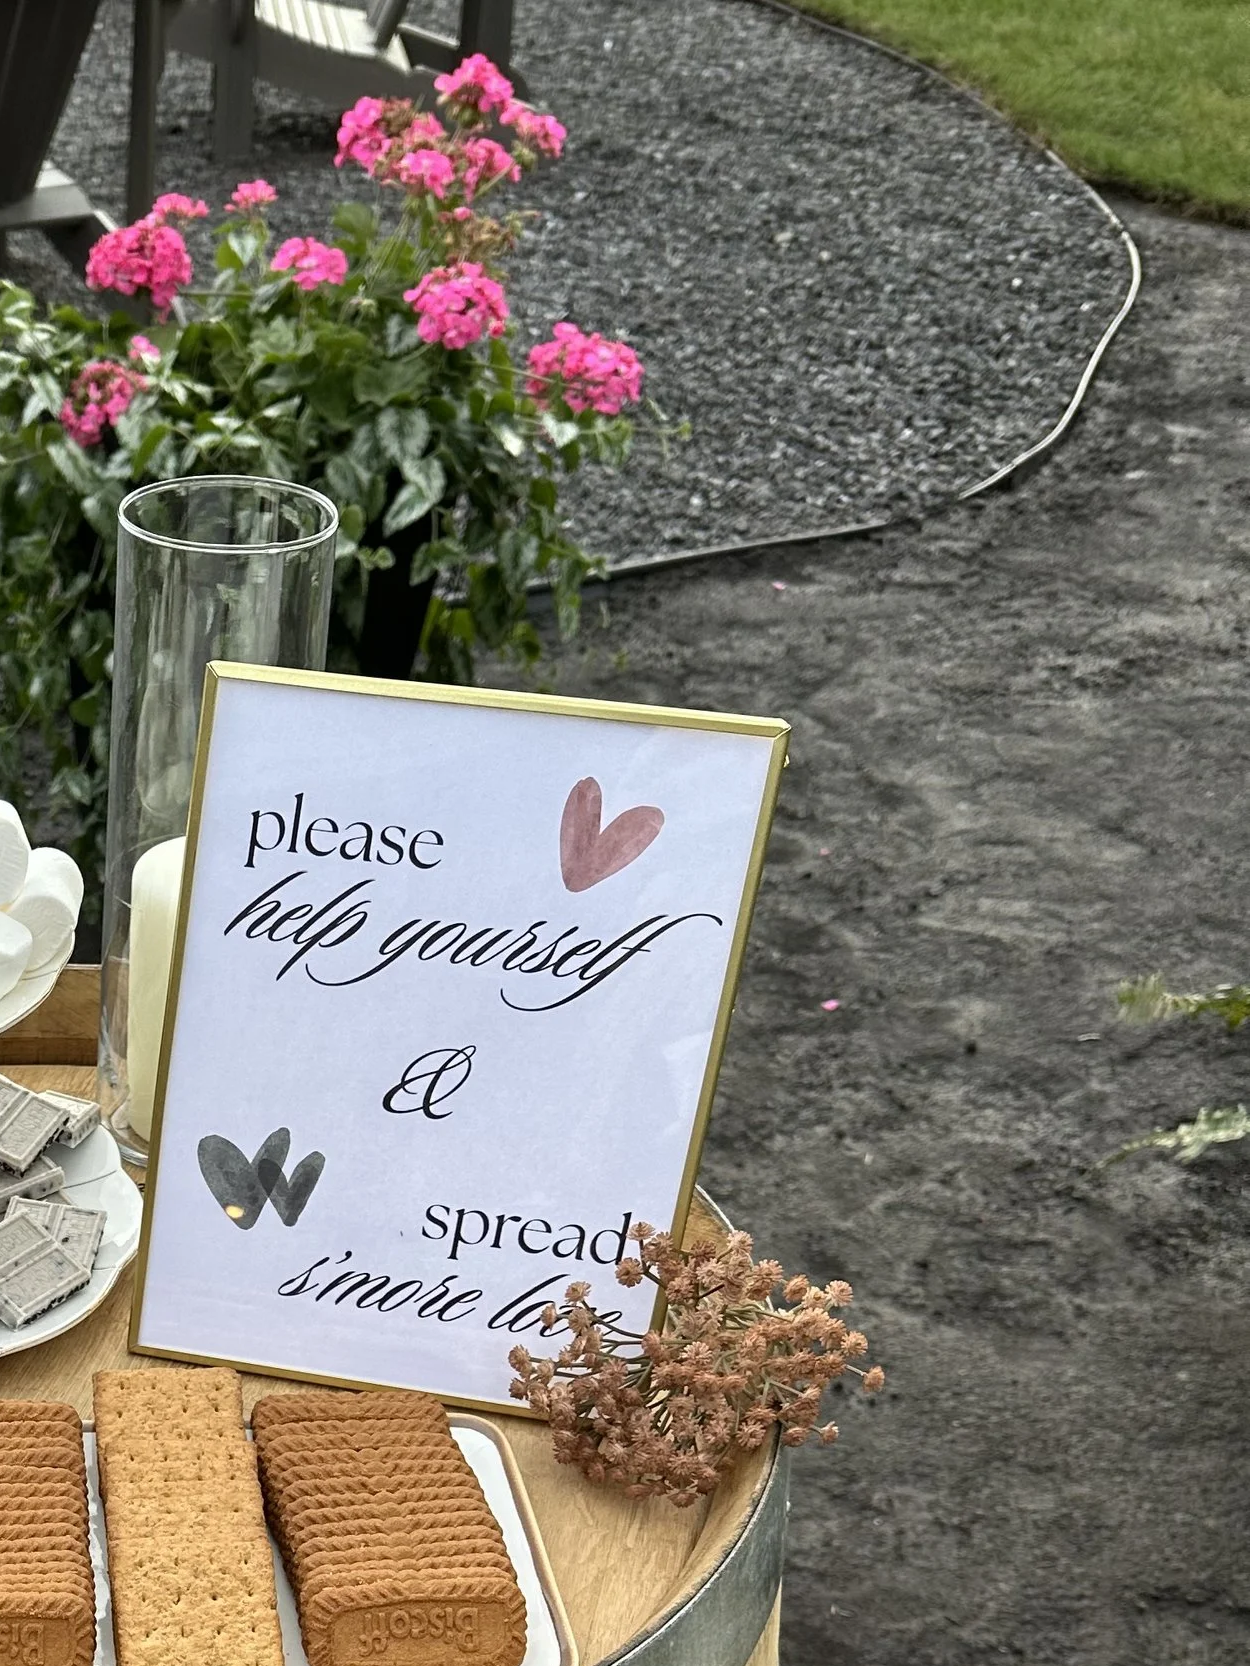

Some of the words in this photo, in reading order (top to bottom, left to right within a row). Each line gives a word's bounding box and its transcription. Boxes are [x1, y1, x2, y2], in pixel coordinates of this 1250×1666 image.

[243, 792, 444, 870] please
[223, 870, 375, 981] help
[305, 914, 723, 1012] yourself
[382, 1045, 477, 1119] &
[421, 1203, 632, 1265] spread
[277, 1249, 484, 1322] s'more
[357, 1606, 479, 1657] Biscoff
